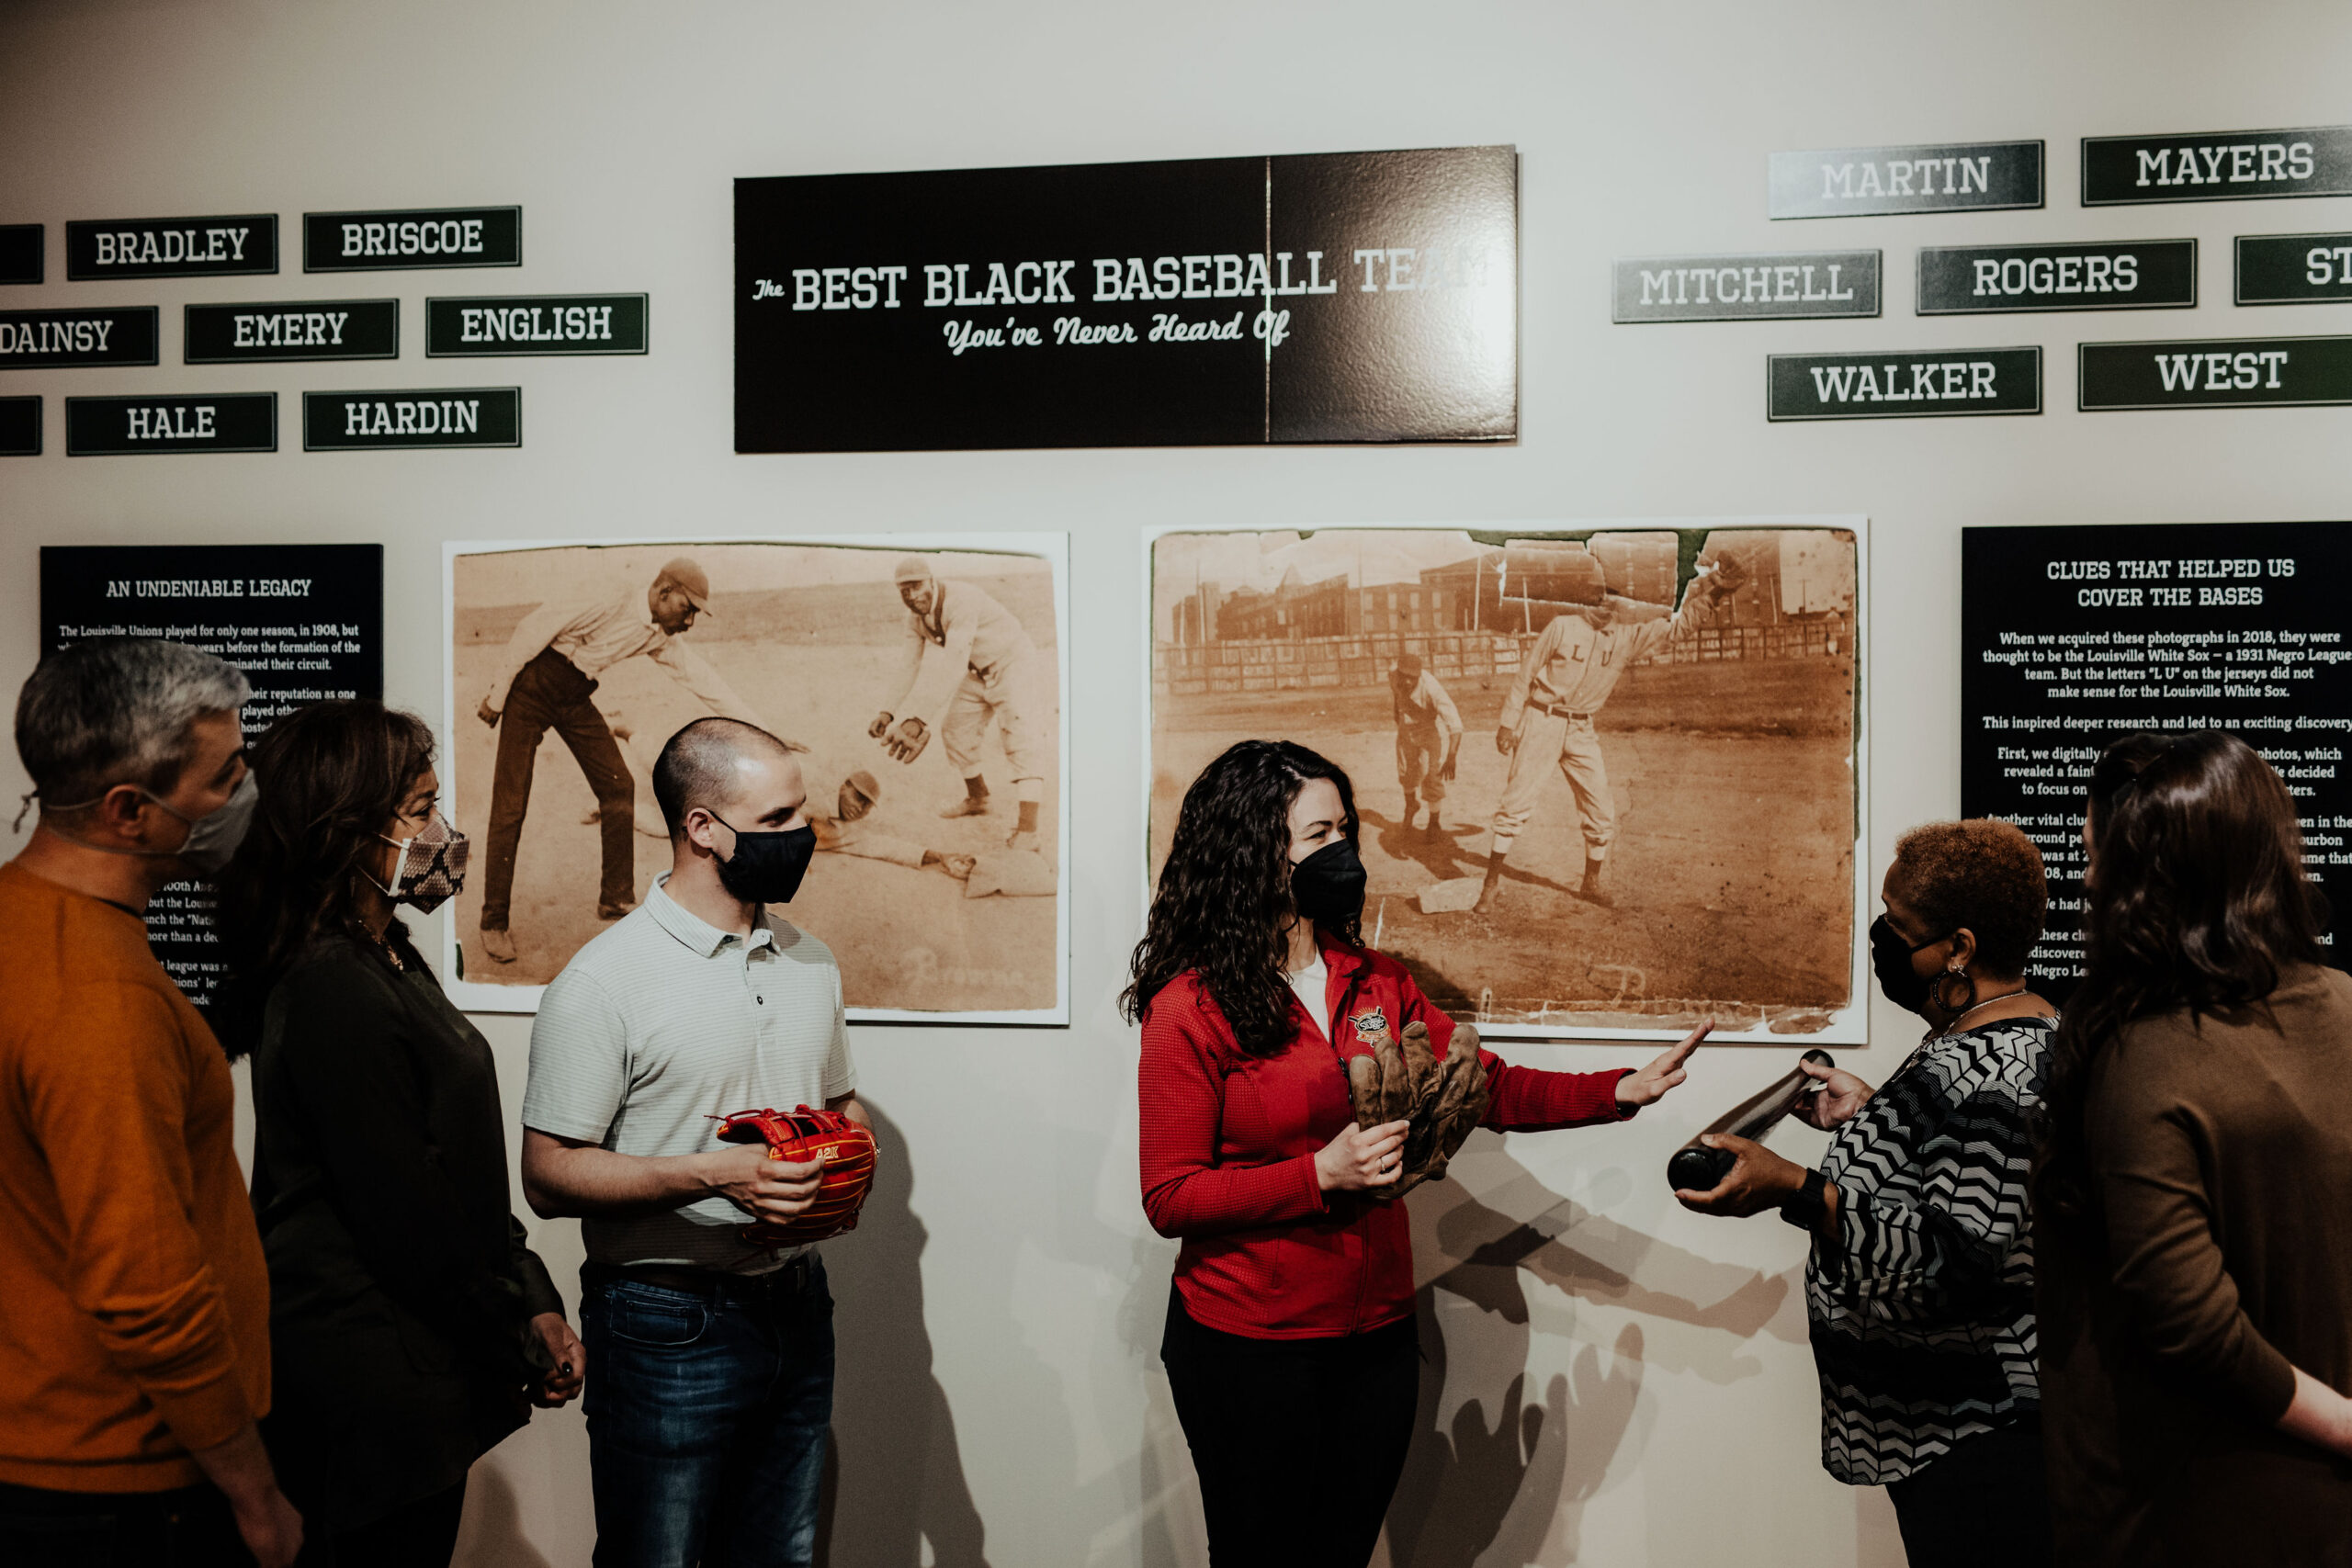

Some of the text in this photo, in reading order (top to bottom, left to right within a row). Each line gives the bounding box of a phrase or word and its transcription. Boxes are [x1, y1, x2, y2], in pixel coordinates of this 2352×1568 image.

[2136, 142, 2314, 187] MAYERS
[1821, 155, 1991, 198] MARTIN
[342, 220, 482, 256] BRISCOE
[96, 228, 249, 265] BRADLEY
[752, 279, 785, 300] The
[793, 266, 907, 310] BEST
[924, 261, 1075, 306] BLACK
[1092, 252, 1338, 302] BASEBALL
[1973, 255, 2137, 296] ROGERS
[1639, 265, 1853, 306] MITCHELL
[234, 312, 348, 346] EMERY
[461, 307, 612, 342] ENGLISH
[944, 309, 1291, 355] You've Never Heard Of
[0, 321, 113, 353] DAINSY
[2154, 352, 2288, 390] WEST
[1810, 362, 1996, 402] WALKER
[128, 407, 215, 439] HALE
[345, 400, 479, 434] HARDIN
[2048, 558, 2294, 580] CLUES THAT HELPED US
[107, 580, 311, 597] AN UNDENIABLE LEGACY
[2078, 587, 2262, 606] COVER THE BASES
[59, 624, 358, 639] The Louisville Unions played for only one season, in 1908, but
[2000, 630, 2341, 648] When we acquired these photographs in 2018, they were
[227, 641, 258, 653] before
[261, 641, 277, 652] the
[279, 641, 329, 653] formation
[332, 641, 342, 653] of
[345, 641, 360, 652] the
[271, 658, 294, 670] their
[298, 658, 332, 670] circuit.
[1572, 645, 1613, 667] L U
[1983, 649, 2029, 666] thought
[2032, 650, 2044, 661] to
[2048, 649, 2062, 662] be
[2065, 649, 2084, 661] the
[2087, 649, 2144, 661] Louisville
[2148, 649, 2184, 661] White
[2188, 649, 2209, 661] Sox
[2226, 652, 2233, 660] a
[2236, 649, 2263, 660] 1931
[2267, 649, 2304, 664] Negro
[2309, 649, 2352, 665] League
[2025, 669, 2057, 680] team.
[2062, 668, 2081, 680] But
[2085, 667, 2104, 680] the
[2108, 667, 2145, 680] letters
[2183, 671, 2199, 679] on
[2202, 667, 2222, 679] the
[2224, 667, 2267, 682] jerseys
[2270, 666, 2290, 679] did
[2293, 667, 2313, 679] not
[248, 687, 356, 703] heir reputation as one
[2048, 684, 2290, 697] make sense for the Louisville White Sox.
[243, 705, 274, 719] played
[1983, 716, 2008, 728] This
[2012, 716, 2060, 732] inspired
[2064, 716, 2104, 732] deeper
[2108, 716, 2159, 728] research
[2163, 716, 2184, 728] and
[2188, 716, 2206, 728] led
[2210, 717, 2222, 728] to
[2225, 719, 2240, 728] an
[2244, 716, 2292, 732] exciting
[1998, 747, 2029, 761] First,
[2032, 750, 2049, 759] we
[2052, 747, 2100, 763] digitally
[2304, 748, 2342, 760] which
[2005, 764, 2053, 777] revealed
[2057, 768, 2064, 777] a
[2288, 765, 2335, 778] decided
[2022, 784, 2034, 795] to
[2037, 783, 2070, 795] focus
[2073, 786, 2087, 795] on
[2037, 813, 2352, 828] vital in the
[2299, 833, 2344, 846] ourbon
[2041, 852, 2064, 861] was
[2068, 850, 2079, 861] at
[2329, 852, 2352, 863] that
[2044, 867, 2064, 881] 08,
[167, 897, 182, 908] the
[2059, 897, 2080, 909] had
[169, 914, 184, 924] the
[171, 931, 192, 942] than
[2039, 928, 2069, 942] hese
[167, 960, 198, 975] league
[816, 1145, 839, 1160] A2K
